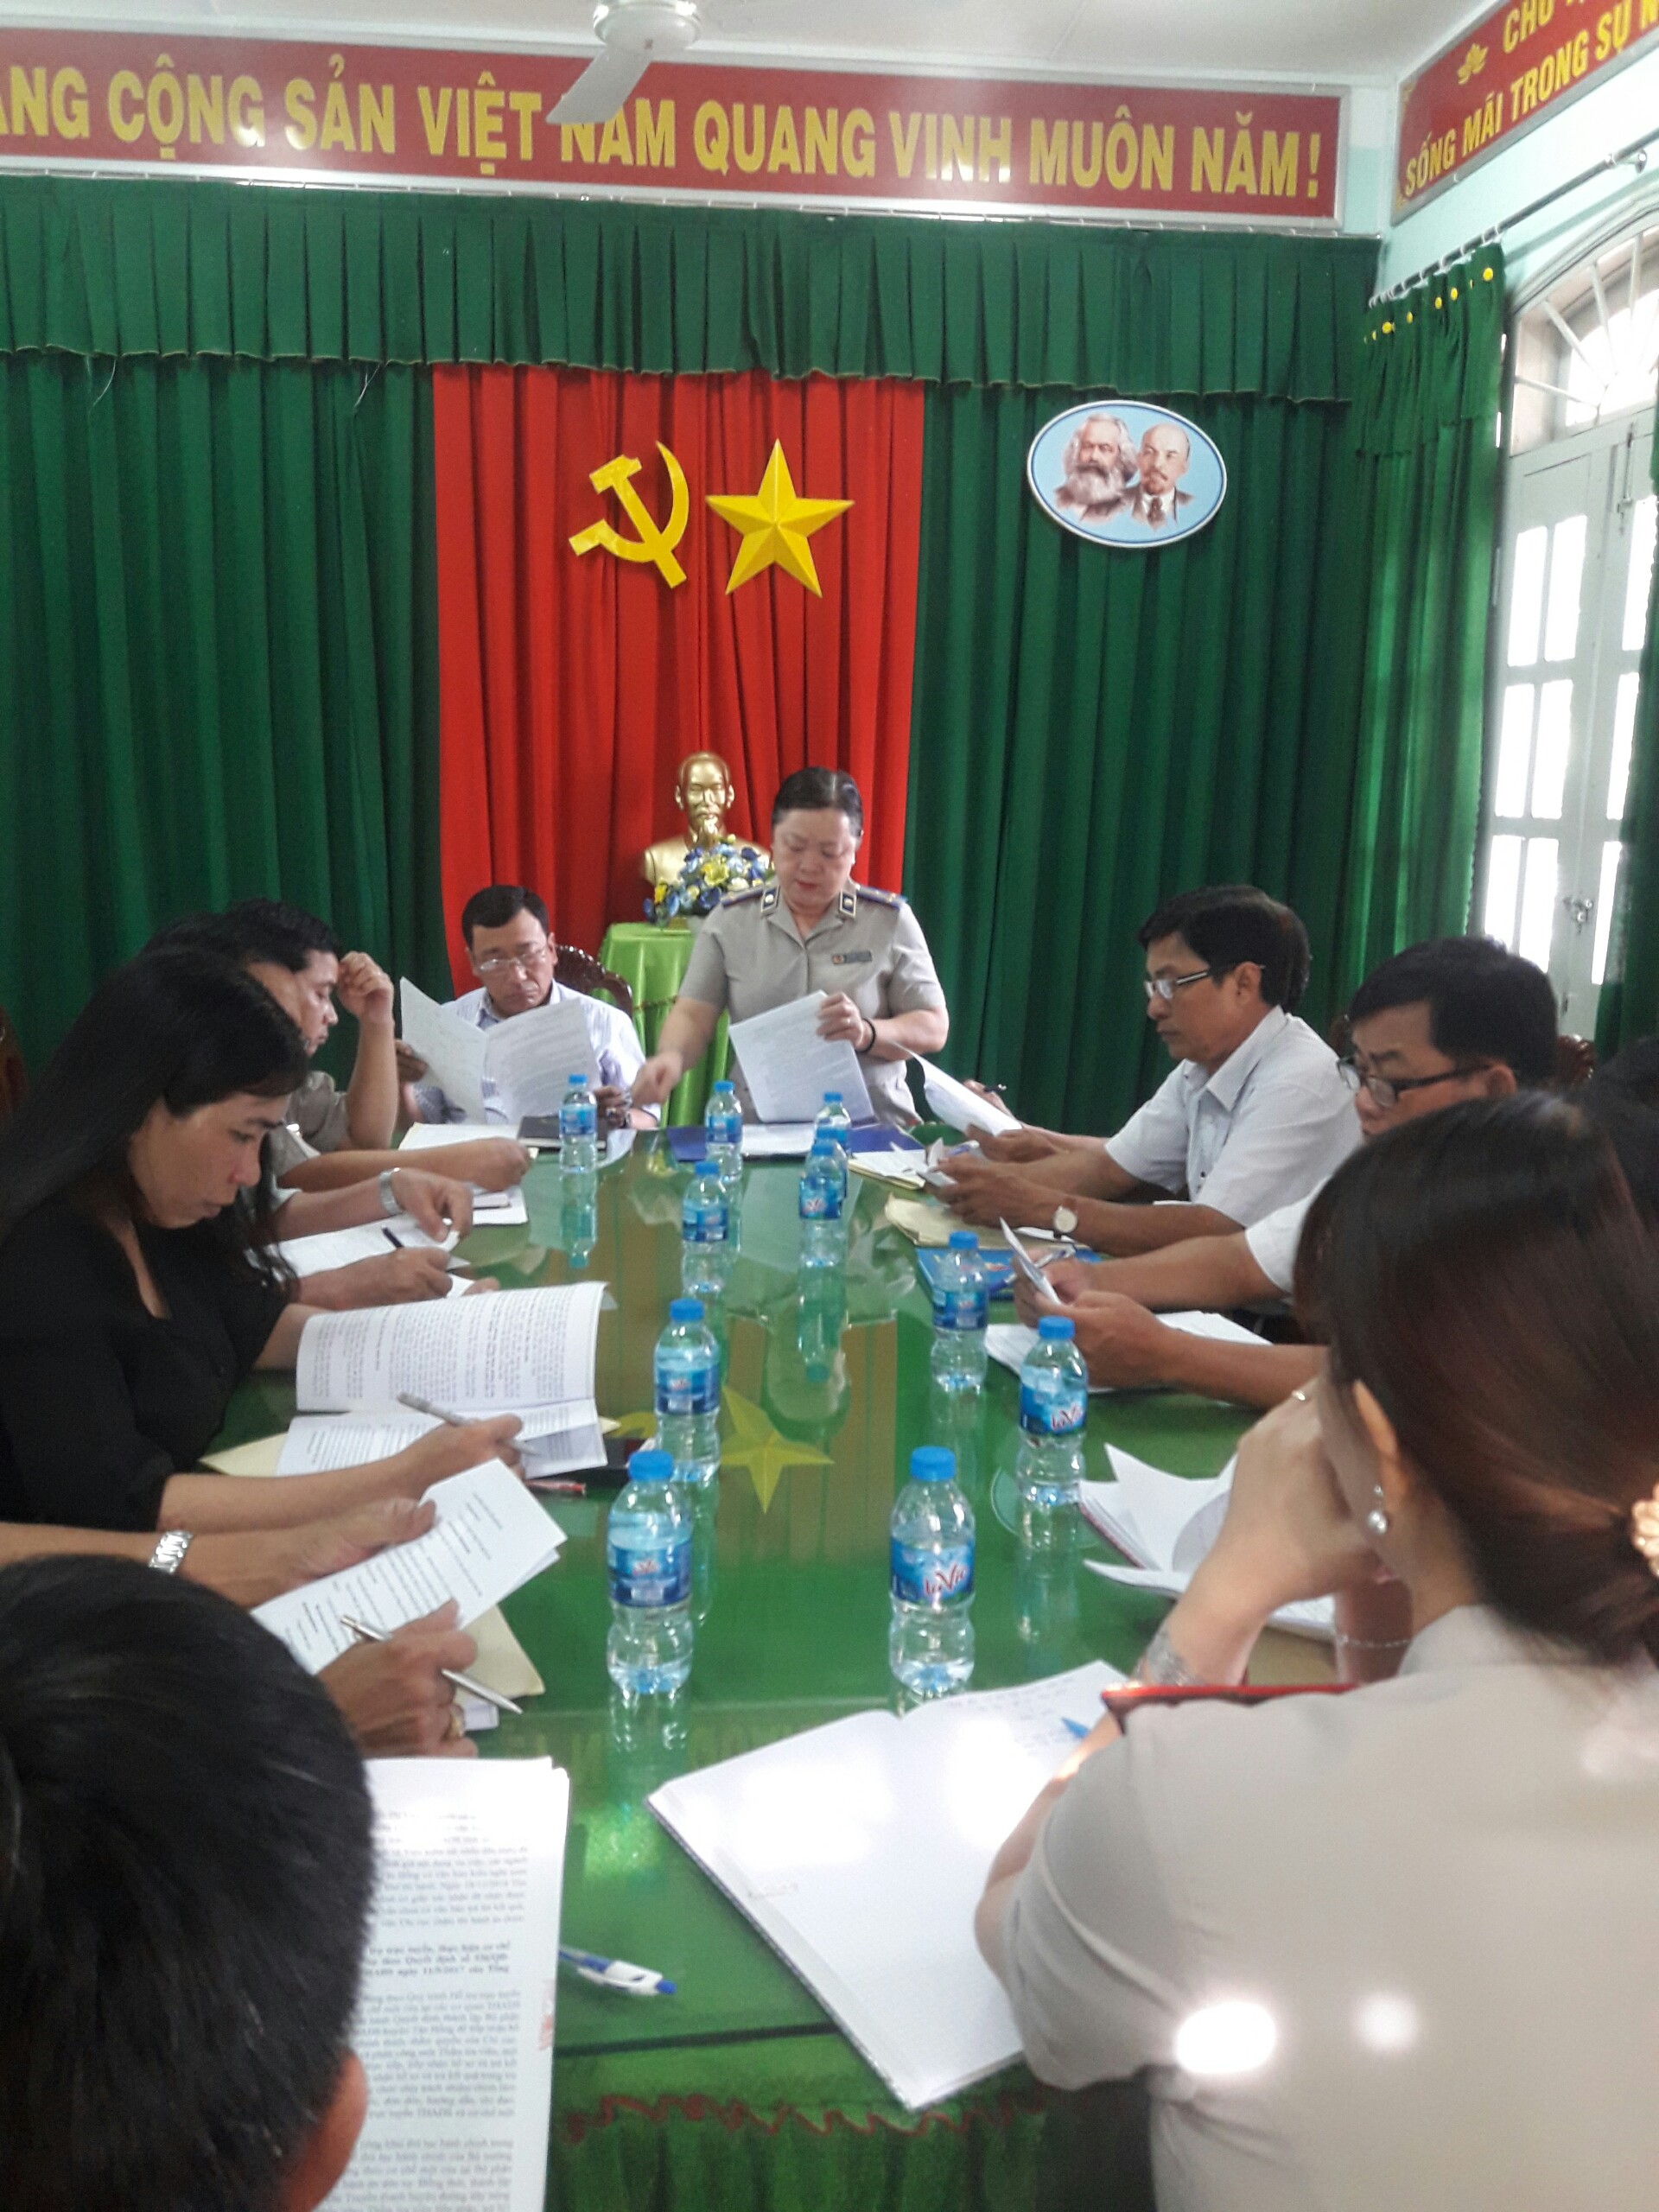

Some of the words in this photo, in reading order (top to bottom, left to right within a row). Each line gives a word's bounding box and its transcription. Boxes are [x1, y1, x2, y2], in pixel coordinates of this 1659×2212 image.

[108, 53, 265, 159] CỘNG
[284, 54, 395, 154] SẢN
[417, 72, 542, 175] VIỆT
[561, 94, 676, 168] NAM
[694, 99, 875, 177] QUANG
[888, 111, 1012, 184] VINH
[1029, 104, 1174, 190] MUÔN
[1510, 29, 1589, 122] TRONG
